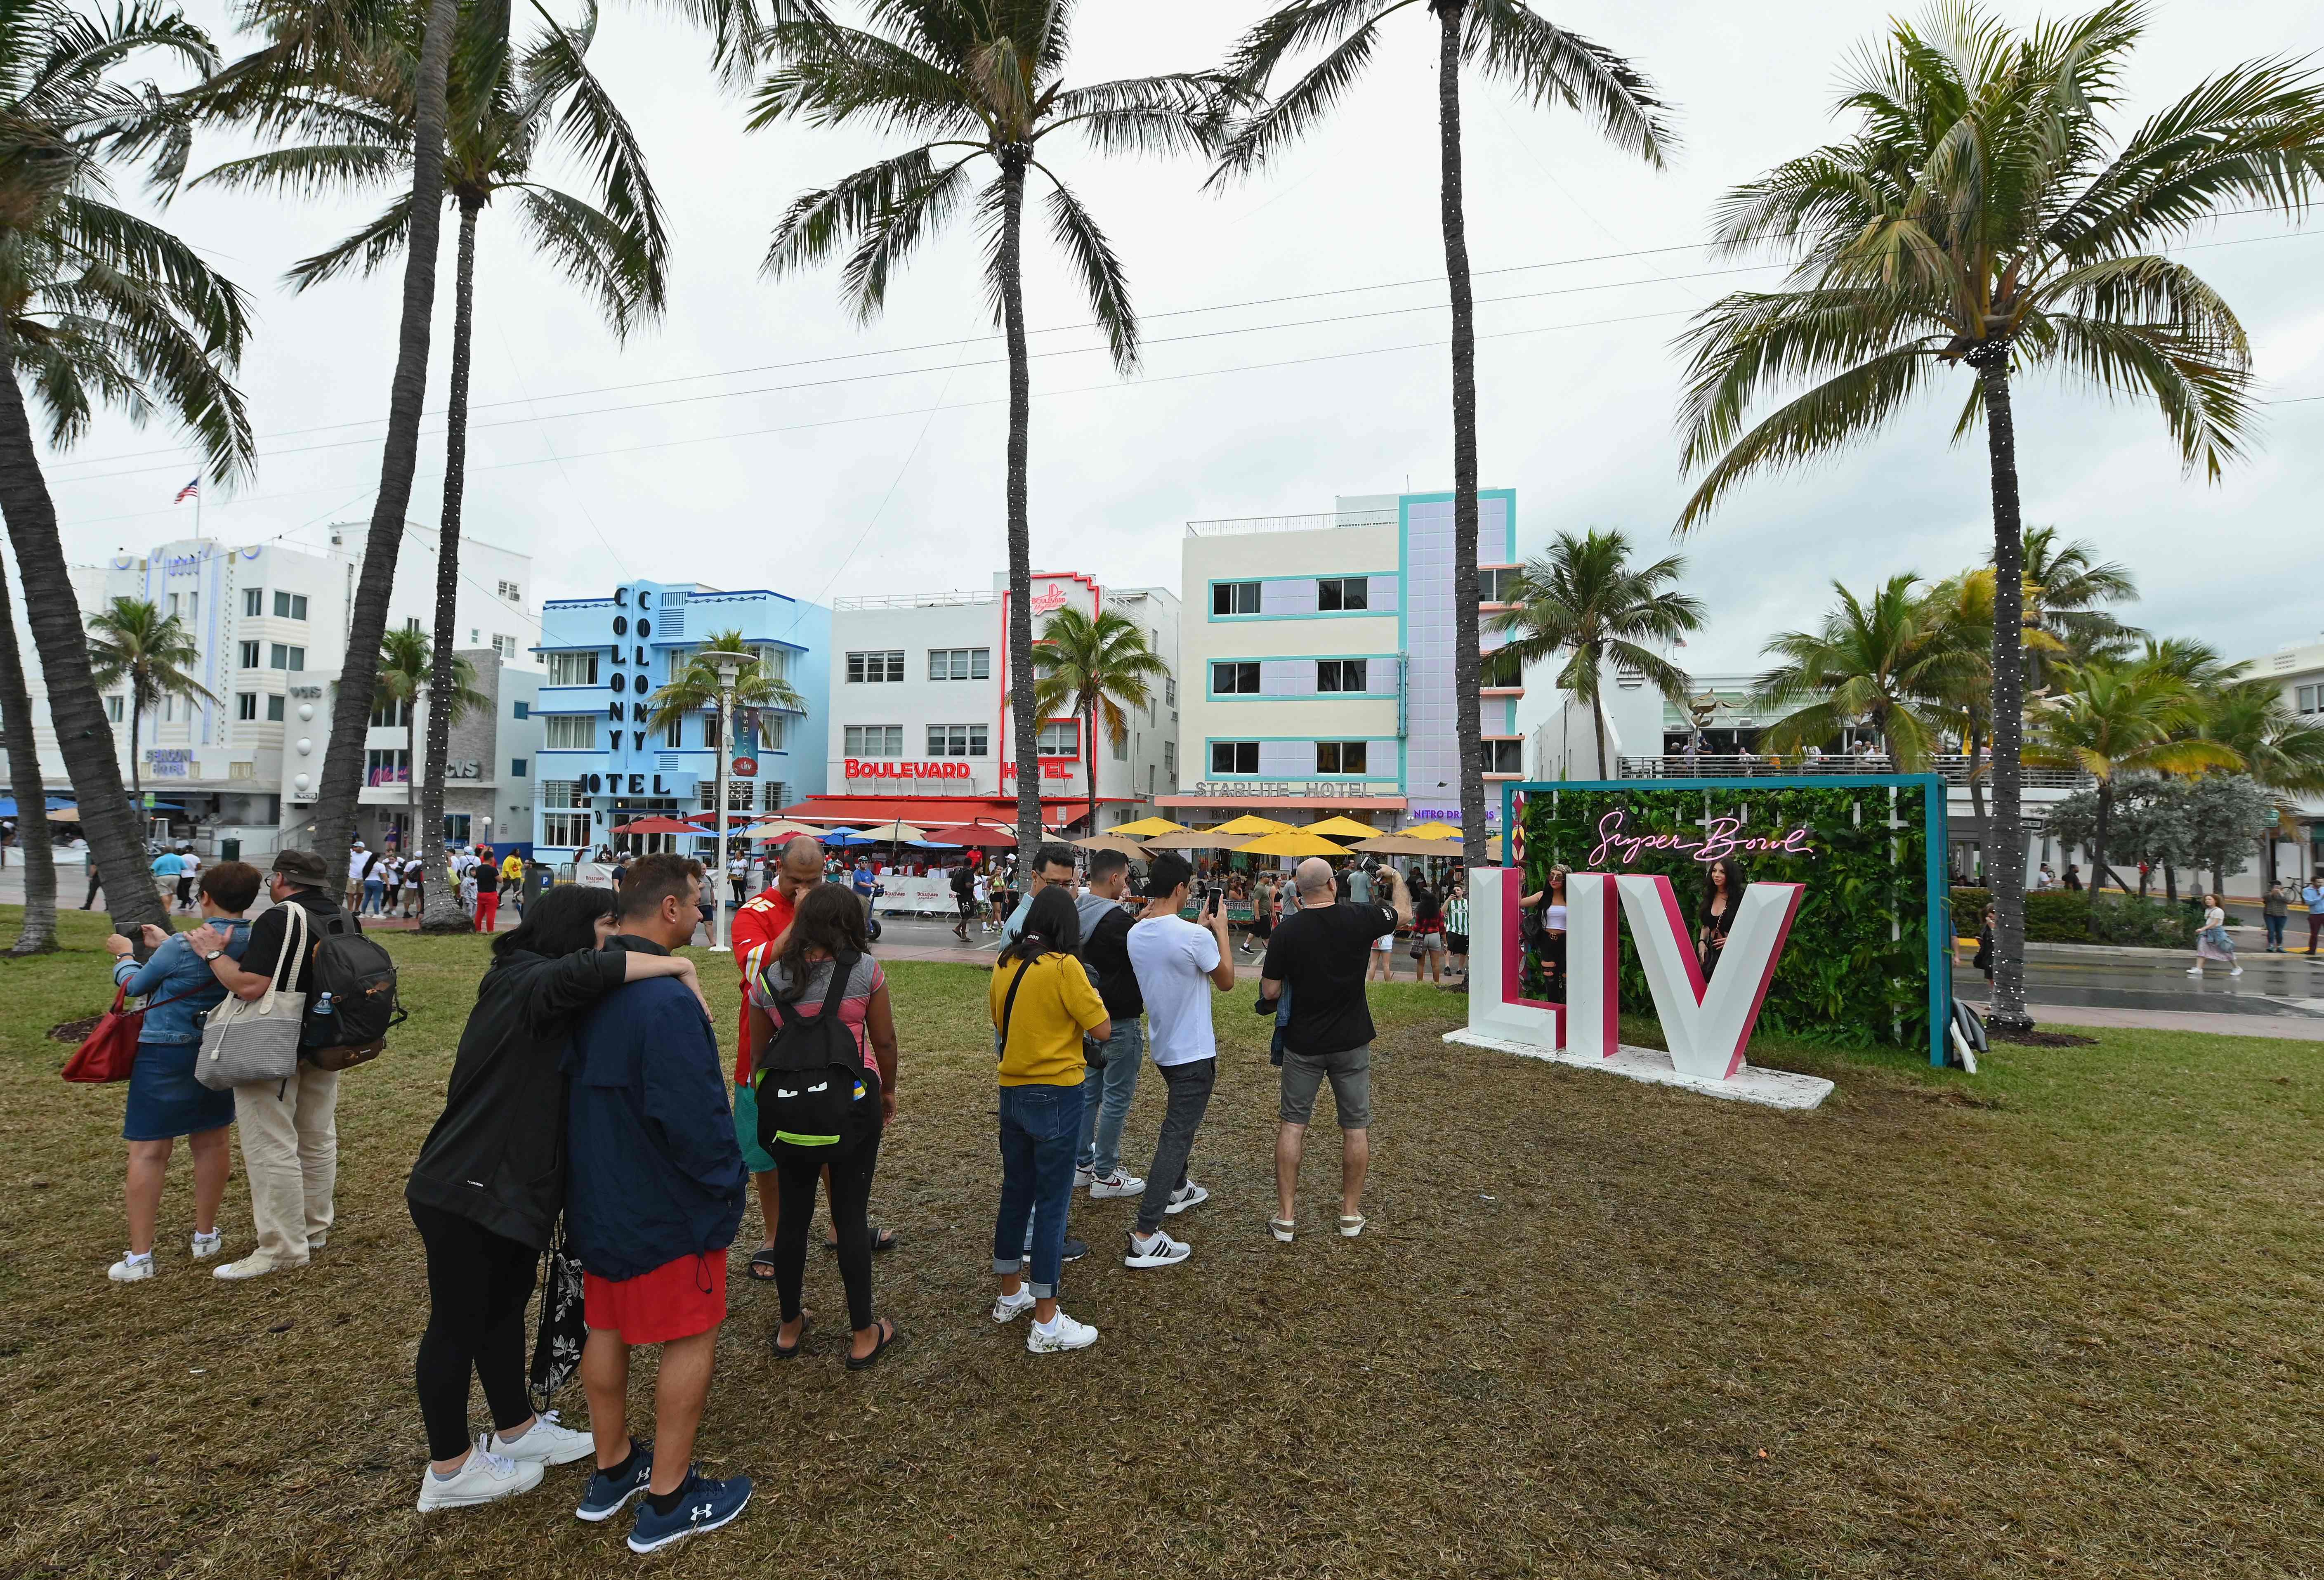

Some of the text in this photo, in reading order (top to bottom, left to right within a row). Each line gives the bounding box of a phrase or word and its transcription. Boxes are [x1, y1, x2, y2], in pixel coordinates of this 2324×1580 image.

[609, 587, 628, 750] COLONY
[633, 591, 651, 751] COLONY
[445, 758, 479, 777] CVS
[844, 758, 1073, 779] BOULEVARD HTEL
[580, 773, 670, 794] HOTEL
[1195, 782, 1374, 798] STARLITE HOTEL
[1414, 810, 1444, 819] NITRO
[1588, 811, 1814, 866] Super Bowl
[740, 897, 776, 912] 25
[1234, 902, 1252, 910] TIME!
[1468, 867, 1806, 1080] LIV
